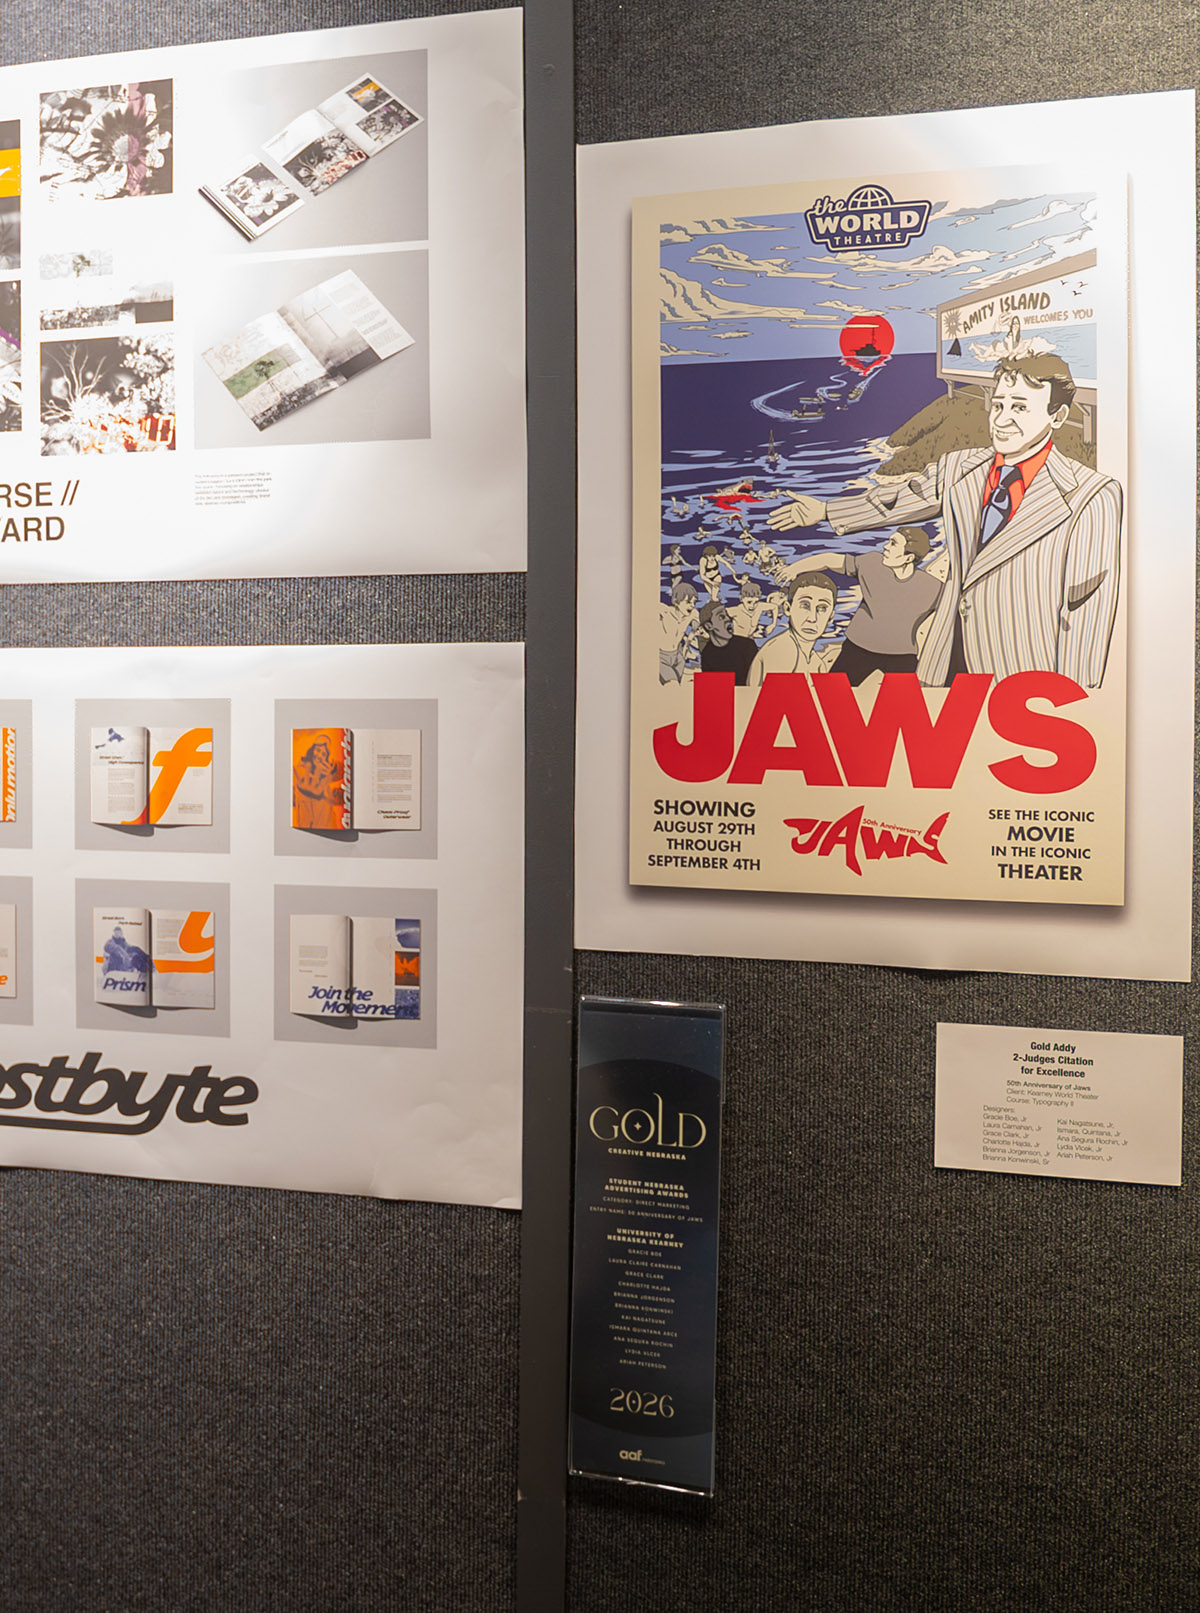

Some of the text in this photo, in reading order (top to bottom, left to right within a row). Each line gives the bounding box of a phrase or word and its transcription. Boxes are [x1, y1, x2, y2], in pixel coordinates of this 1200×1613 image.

[815, 196, 847, 216] the
[815, 210, 920, 235] WORLD
[834, 232, 902, 246] THEATRE
[961, 291, 1051, 334] AMITY ISLAND
[1022, 308, 1094, 325] WELCOMES YOU
[653, 670, 1098, 795] JAWS
[654, 799, 756, 818] SHOWING
[988, 809, 1095, 822] SEE THE ICONIC
[653, 821, 755, 835] AUGUST 29TH
[862, 818, 922, 836] 50th Anniversary
[1007, 826, 1075, 842] MOVIE
[666, 838, 741, 852] THROUGH
[783, 805, 950, 877] JAWS
[991, 845, 1091, 859] IN THE ICONIC
[648, 854, 760, 871] SEPTEMBER 4TH
[998, 863, 1083, 881] THEATER
[103, 977, 146, 992] Prism
[308, 986, 374, 1001] Join the
[1030, 1041, 1076, 1054] Gold Addy
[1013, 1053, 1094, 1066] 2-Judges Citation
[1021, 1066, 1085, 1078] for Excellence
[1023, 1081, 1062, 1090] Anniversary
[589, 1092, 707, 1149] GOLD
[608, 1147, 687, 1161] CREATIVE NEBRASKA
[604, 1184, 689, 1199] ADVERTISING AWARDS
[609, 1177, 685, 1191] STUDENT NEBRASKA
[616, 1227, 662, 1238] UNIVERSITY
[607, 1234, 684, 1249] NEBRASKA KEARNEY
[610, 1387, 675, 1418] 2026
[619, 1449, 642, 1461] aaf
